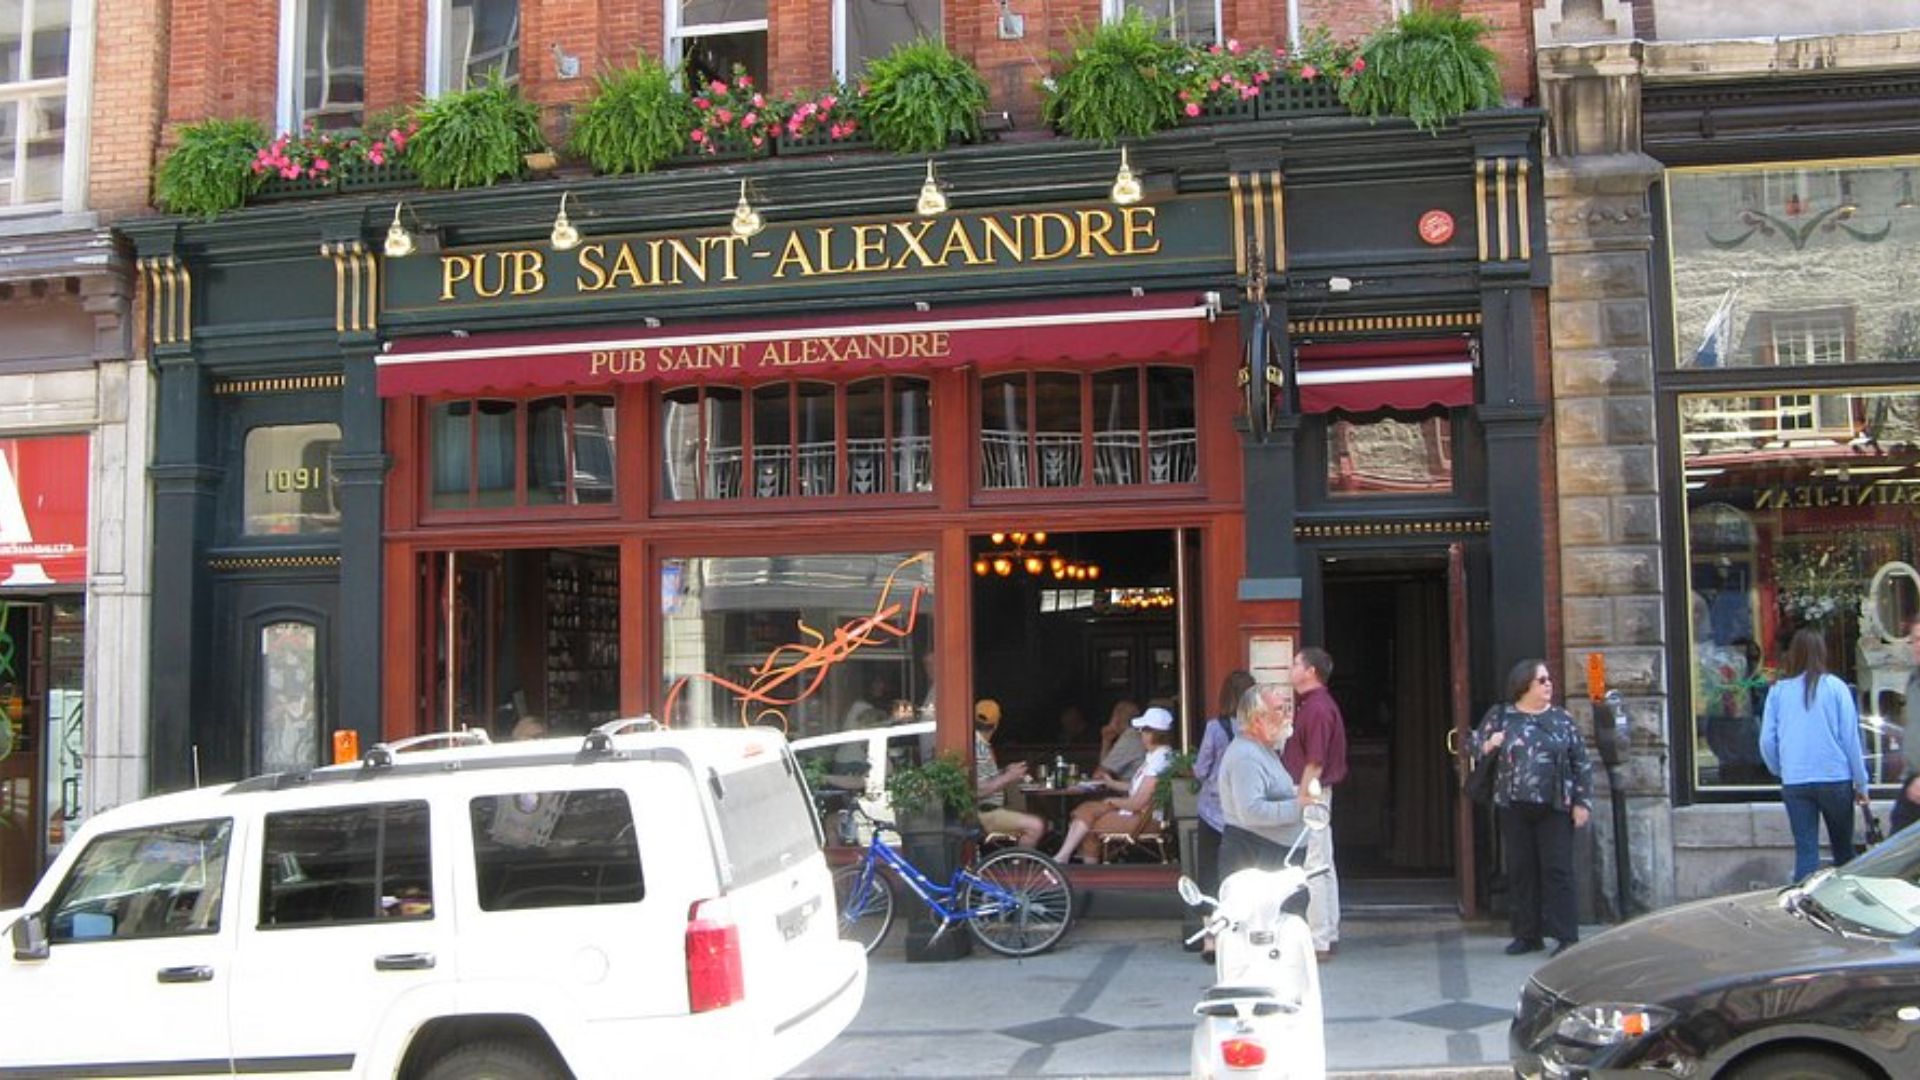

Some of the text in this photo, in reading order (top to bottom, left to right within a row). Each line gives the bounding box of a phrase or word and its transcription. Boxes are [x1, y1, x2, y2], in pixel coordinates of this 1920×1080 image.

[440, 206, 1161, 301] PUB SAINT-ALEXANDRE
[590, 332, 951, 376] PUB SAINT ALEXANDRE
[265, 467, 319, 493] 1091
